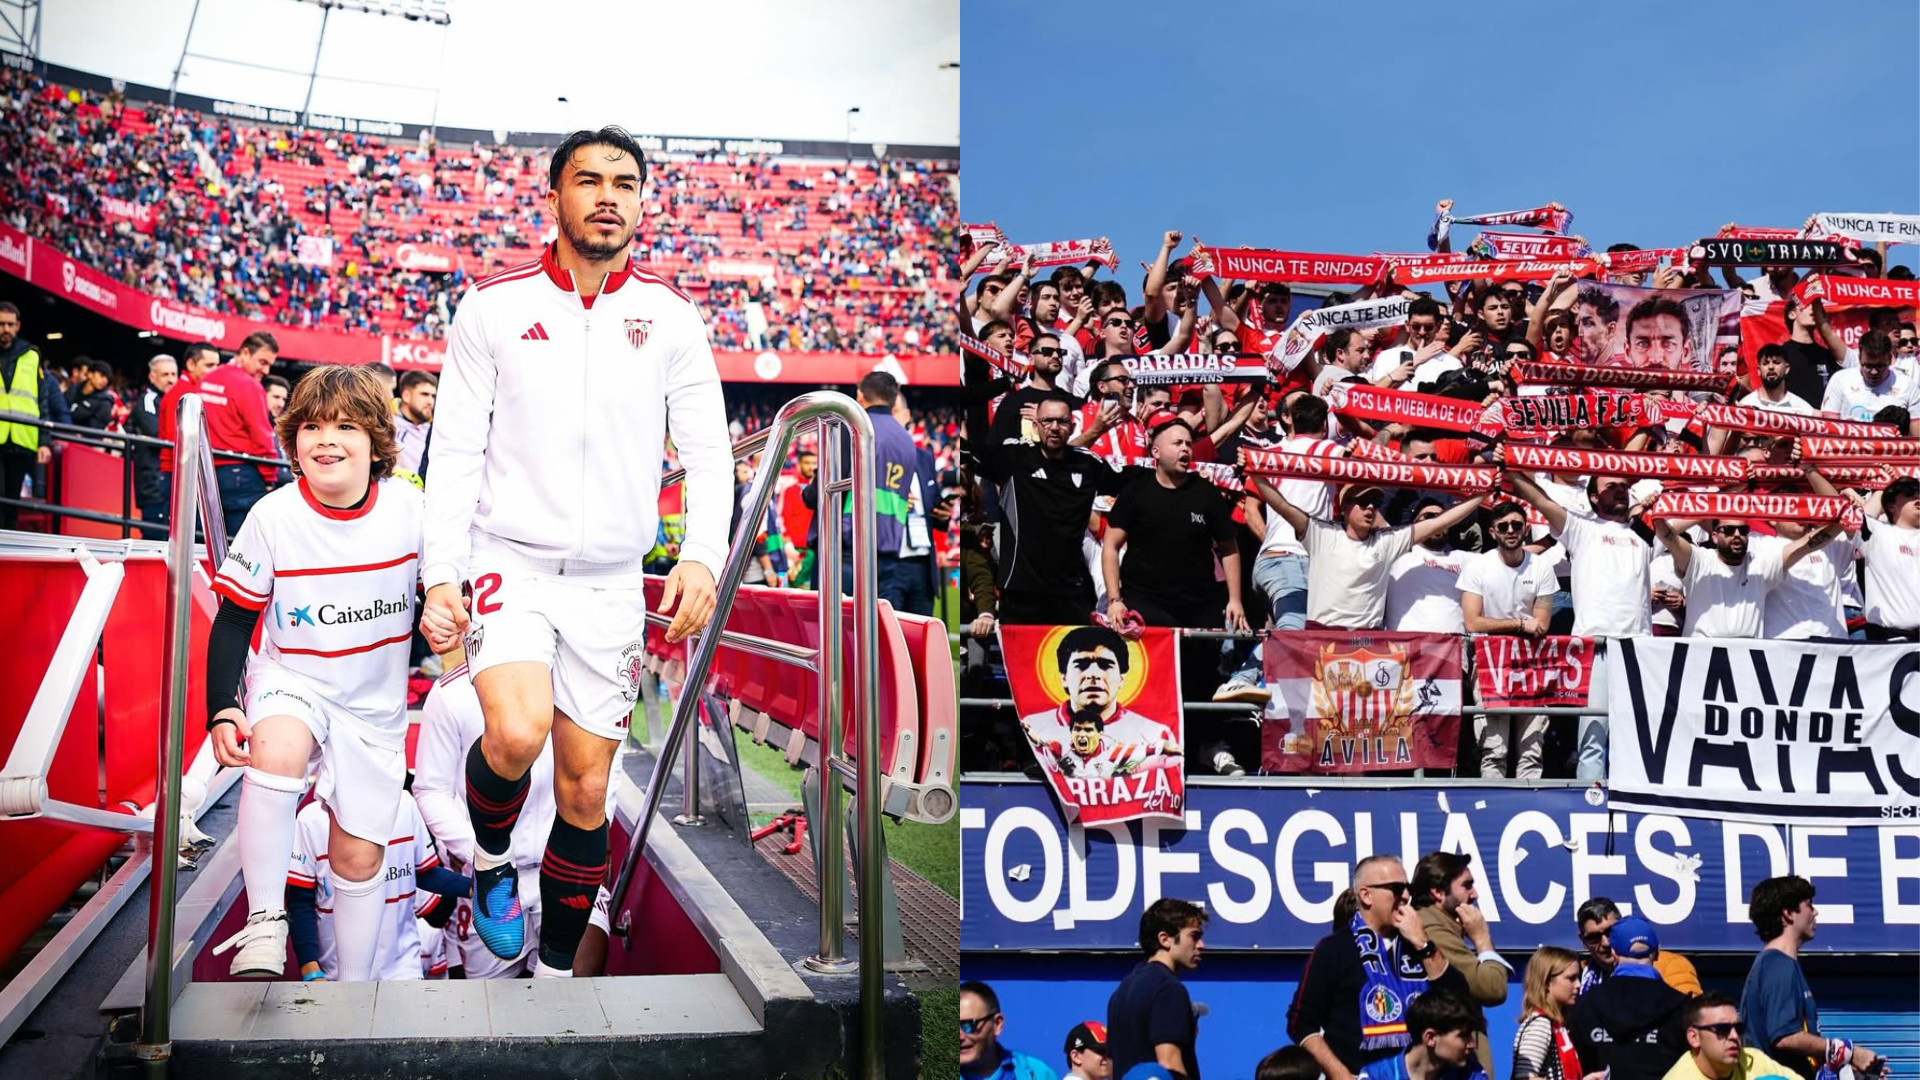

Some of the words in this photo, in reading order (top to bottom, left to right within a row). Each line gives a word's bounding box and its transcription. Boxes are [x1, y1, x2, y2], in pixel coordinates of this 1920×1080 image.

[1826, 217, 1874, 233] NUNCA
[1878, 221, 1894, 233] TE
[1501, 242, 1563, 255] SEVILLA
[1707, 243, 1743, 262] SVQ
[1768, 244, 1837, 260] TRIANA
[1227, 256, 1285, 274] NUNCA
[1289, 260, 1309, 275] TE
[1313, 261, 1374, 276] RINDAS
[1836, 283, 1892, 299] NUNCA
[1893, 286, 1913, 299] TE
[151, 300, 225, 341] Cruzcampo
[1302, 310, 1352, 331] NUNCA
[1354, 307, 1373, 322] TE
[1121, 354, 1237, 373] PARADAS
[1136, 374, 1191, 386] BIRRETE
[1193, 374, 1224, 384] FANS
[1582, 367, 1657, 385] DONDE
[1667, 374, 1729, 390] VAYAS
[1352, 392, 1374, 408] PCS
[1377, 395, 1391, 412] LA
[1395, 398, 1438, 420] PUEBLA
[1439, 405, 1454, 422] DE
[1510, 396, 1590, 426] SEVILLA
[1753, 411, 1829, 432] DONDE
[1806, 438, 1876, 457] VAYAS
[1248, 450, 1323, 474] VAYAS
[1329, 458, 1414, 482] DONDE
[1420, 467, 1493, 487] VAYAS
[1513, 446, 1583, 468] VAYAS
[1588, 452, 1670, 474] DONDE
[1674, 458, 1744, 478] VAYAS
[886, 462, 904, 489] 12
[1716, 495, 1799, 516] DONDE
[1806, 497, 1863, 524] VAYAS
[467, 573, 503, 616] 2
[318, 593, 409, 625] CaixaBank
[1484, 637, 1584, 694] VAYAS
[1619, 637, 1920, 797] VAYAS
[1704, 703, 1862, 744] DONDE
[1319, 733, 1412, 766] ÁVILA
[1143, 790, 1164, 811] del
[1881, 805, 1912, 819] SFC
[1722, 819, 1854, 924] DE
[1590, 1027, 1658, 1044] GEE
